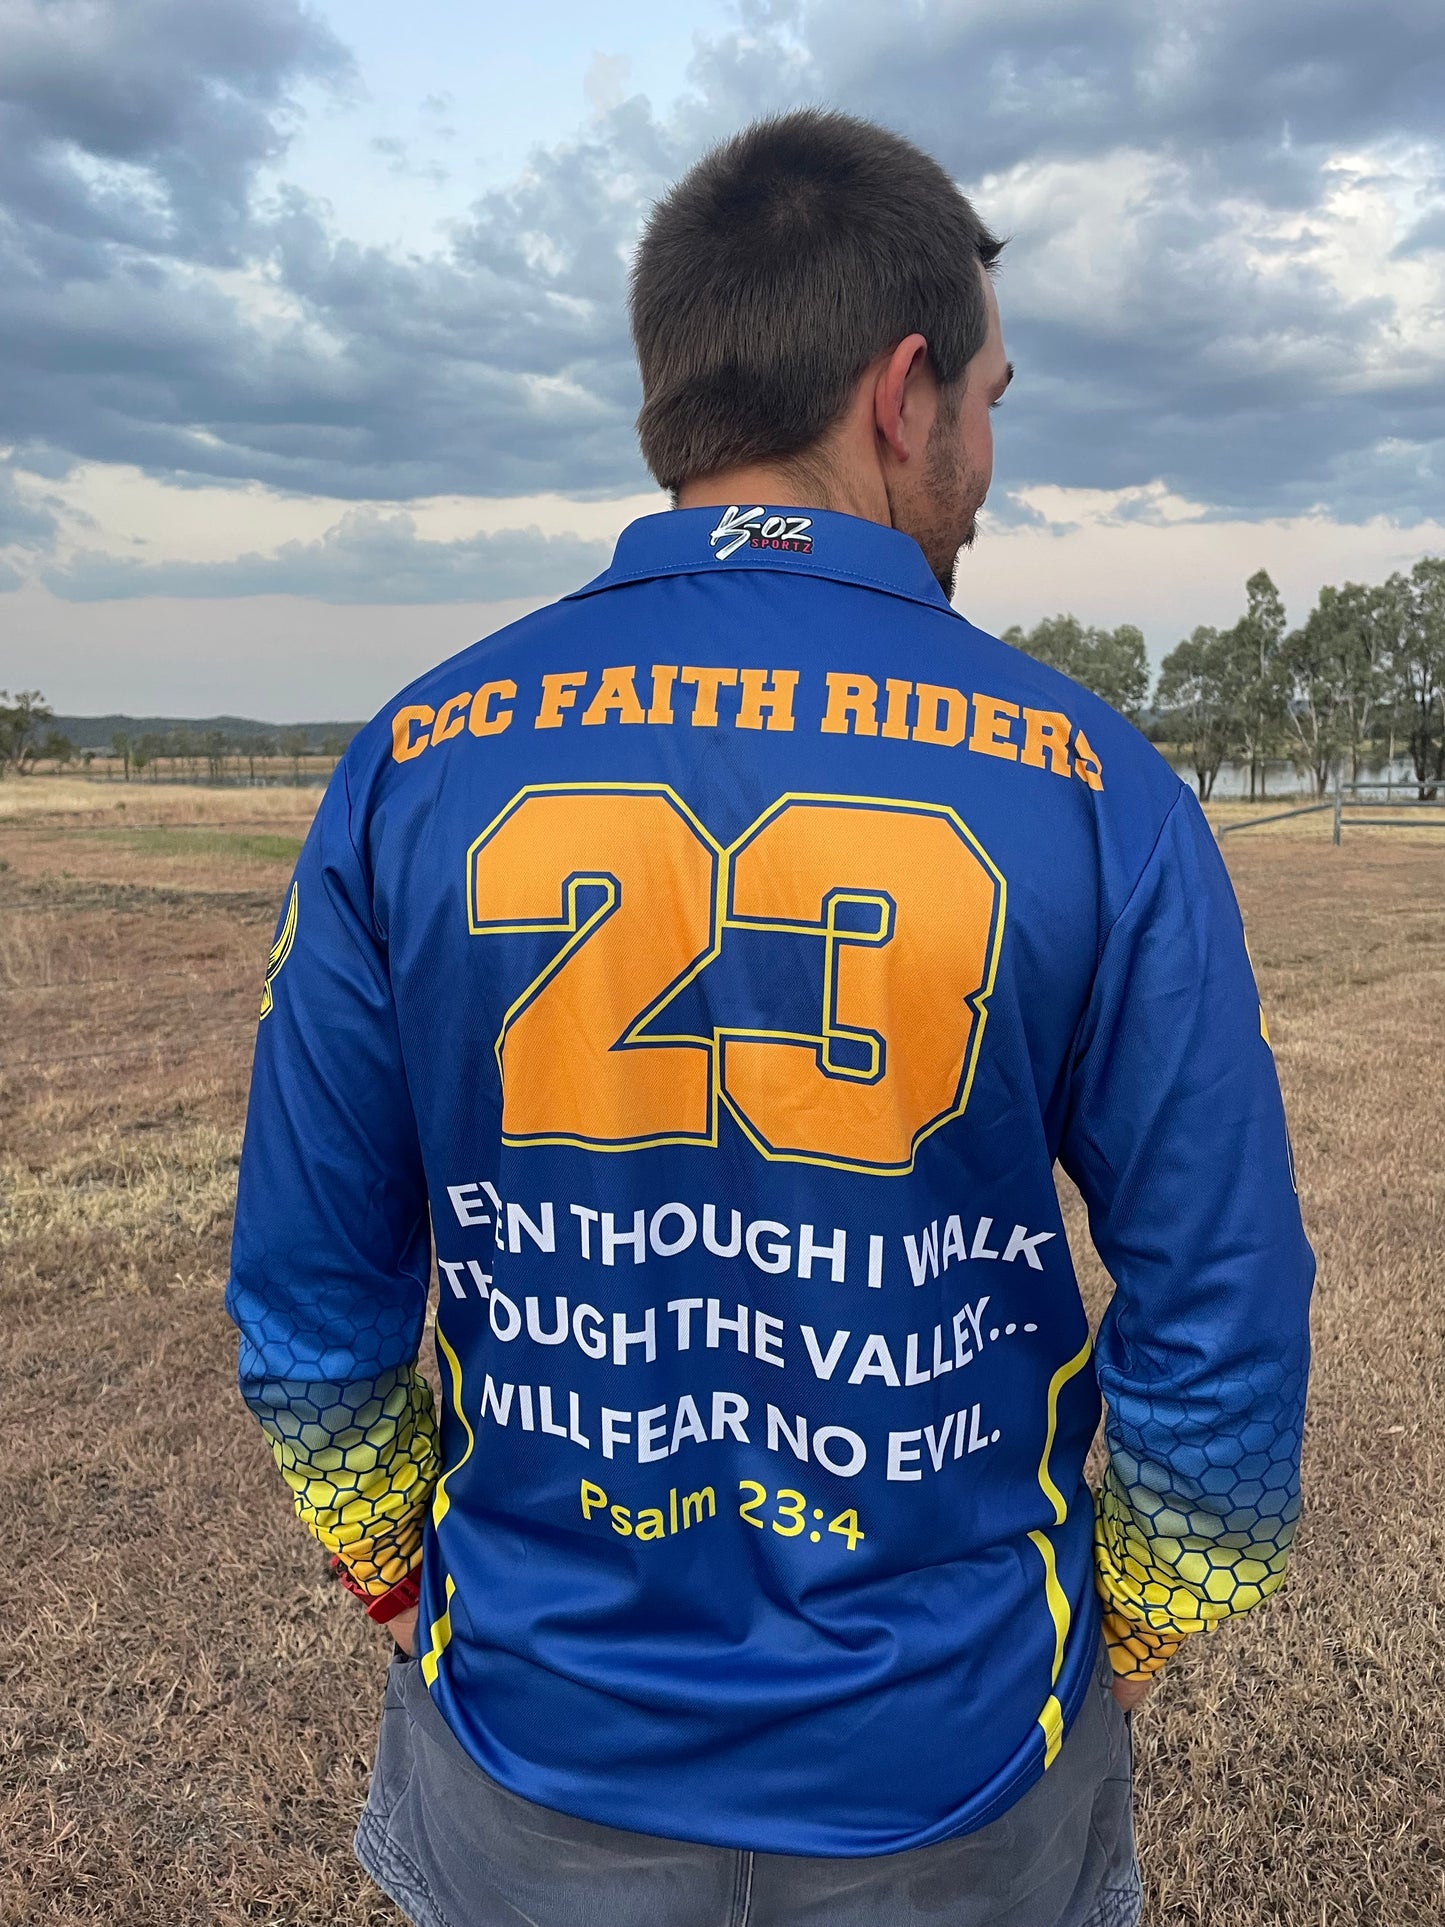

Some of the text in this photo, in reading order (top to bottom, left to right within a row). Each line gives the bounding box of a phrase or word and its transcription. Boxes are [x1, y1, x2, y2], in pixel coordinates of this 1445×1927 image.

[751, 538, 813, 553] SPORTZ
[391, 664, 1105, 791] CCC FAITH RIDERS
[466, 781, 1007, 1176] 23
[446, 1180, 1057, 1289] EN THOUGH I WALK
[667, 1297, 785, 1369] THE
[799, 1295, 1038, 1387] VALLEY...
[601, 1391, 750, 1464] FEAR
[766, 1402, 867, 1477] NO
[886, 1402, 1001, 1481] EVIL.
[580, 1478, 865, 1551] Psalm 23:4
